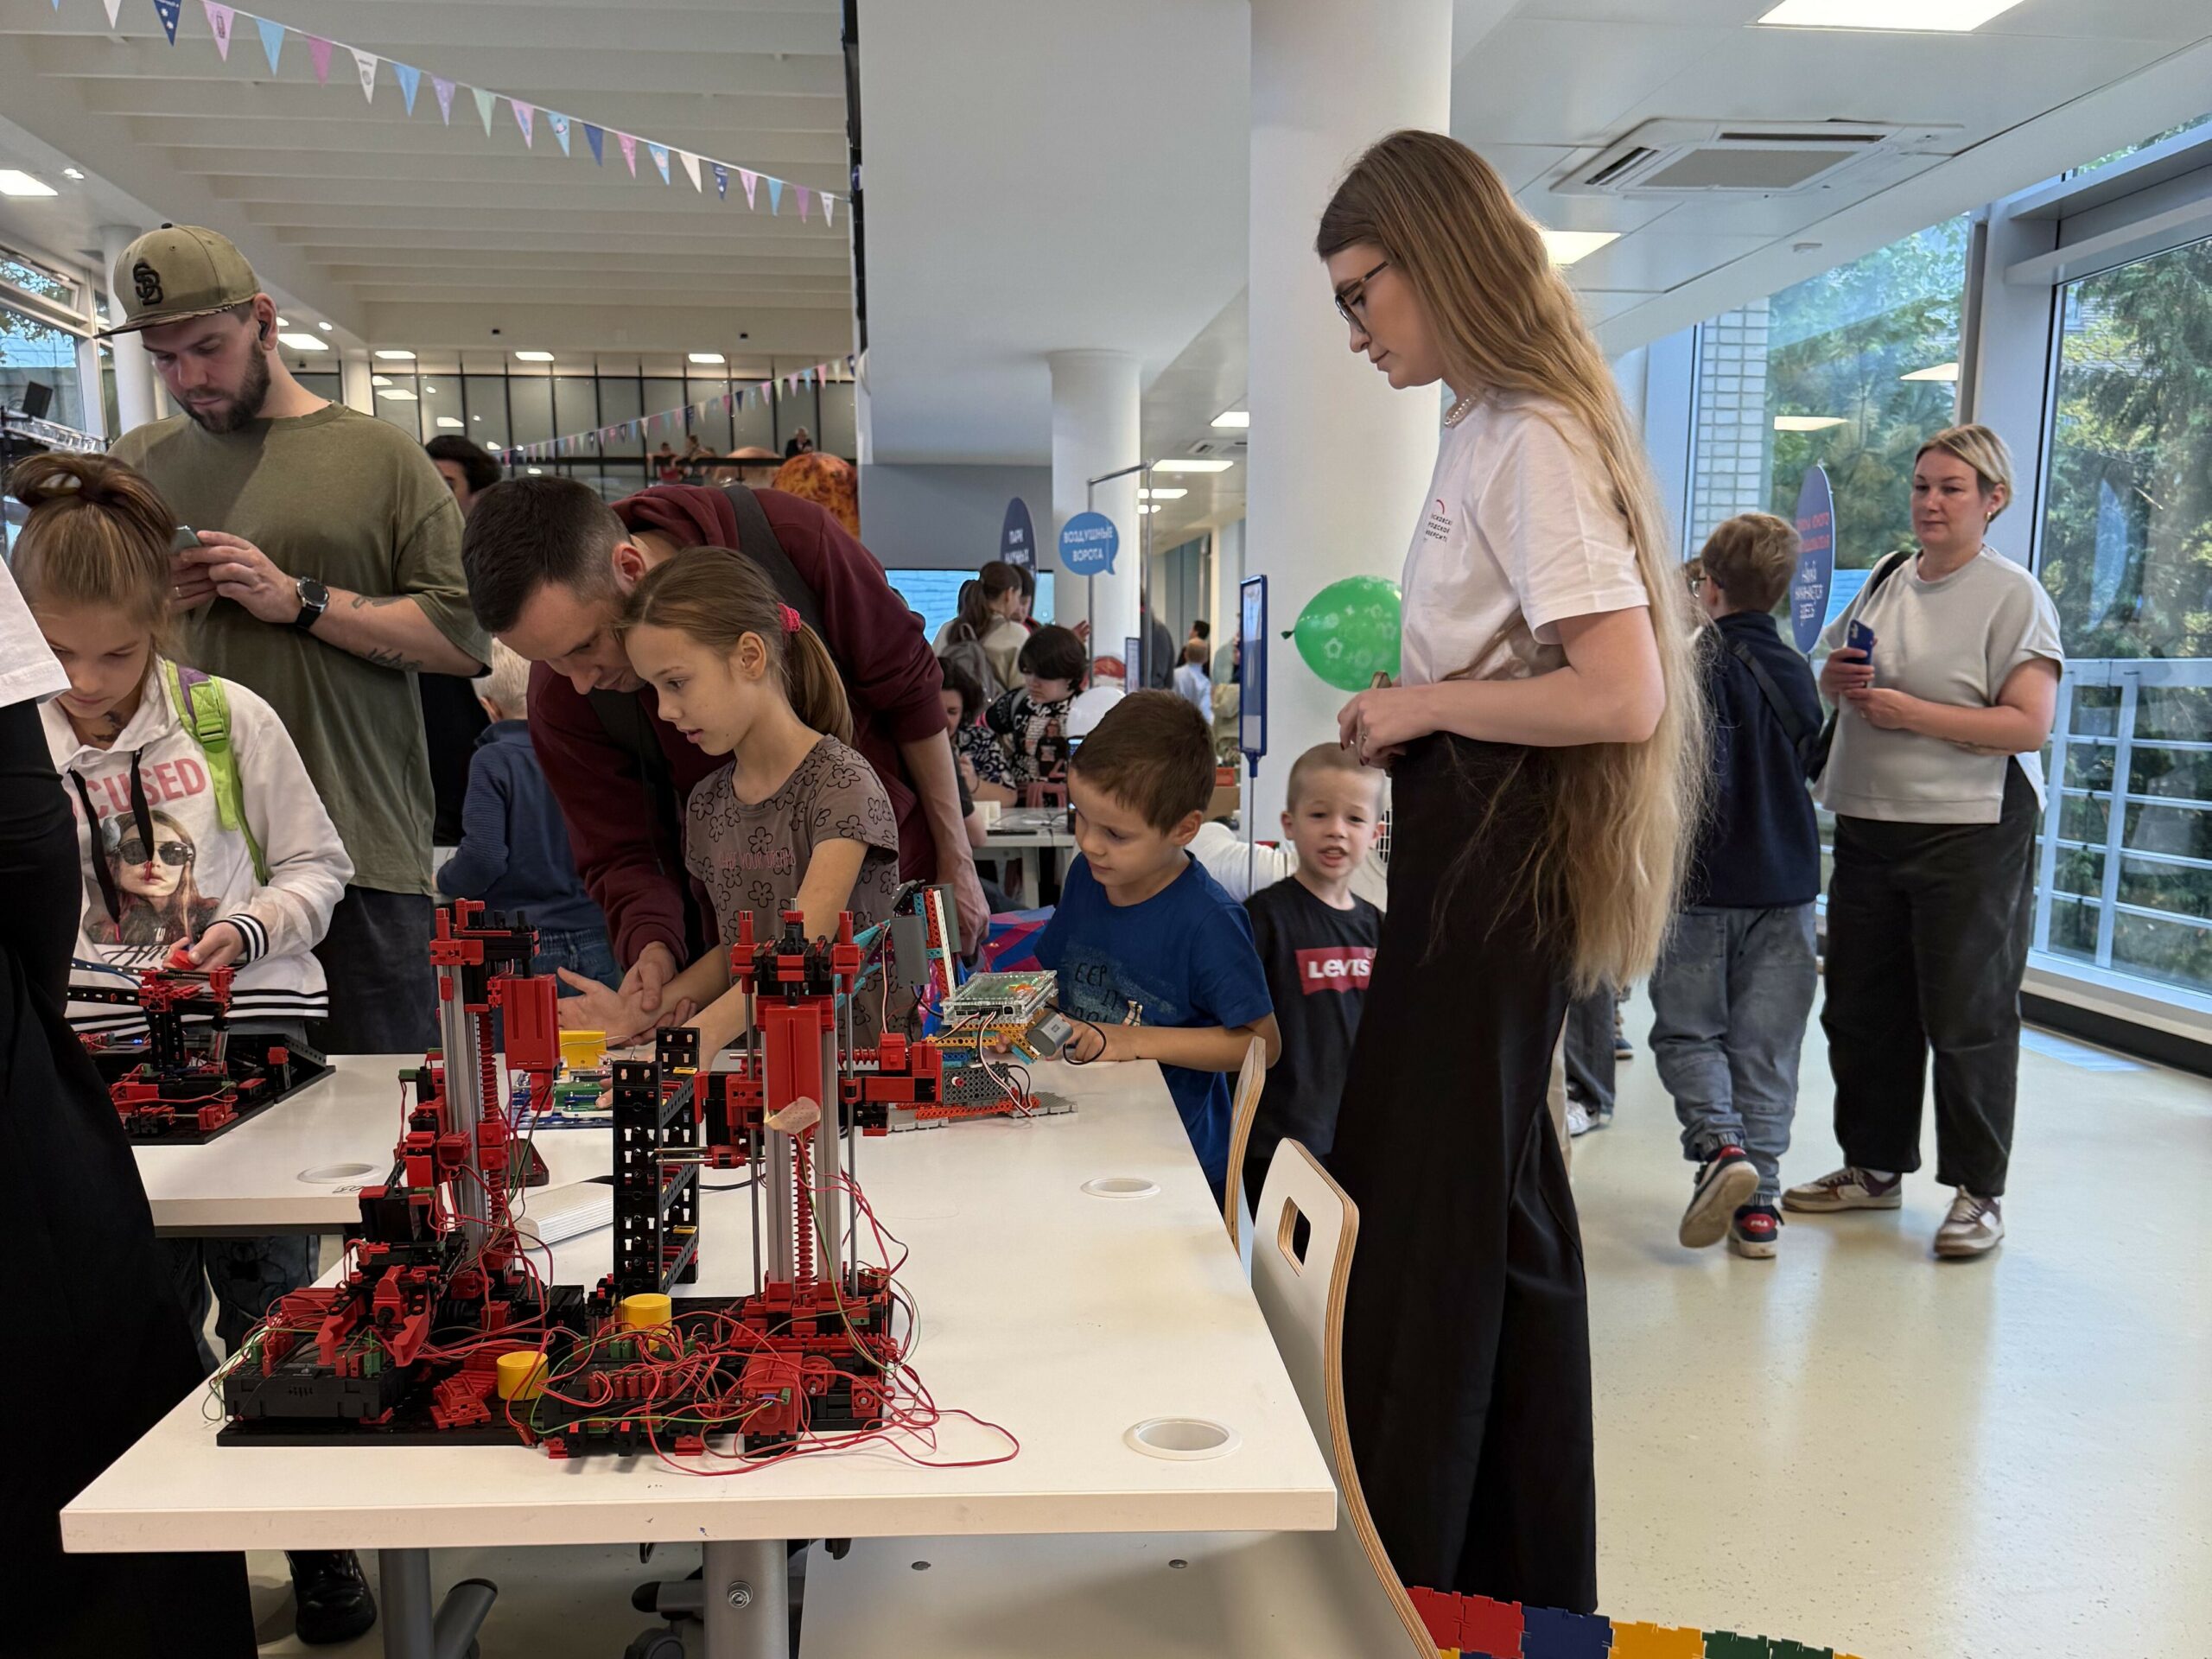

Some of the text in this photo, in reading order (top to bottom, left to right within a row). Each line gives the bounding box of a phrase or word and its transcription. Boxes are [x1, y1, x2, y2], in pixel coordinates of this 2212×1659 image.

[1064, 526, 1113, 543] ВОЗДУШНЫЕ
[1072, 549, 1103, 562] ВОРОТА
[84, 758, 207, 819] CUSED
